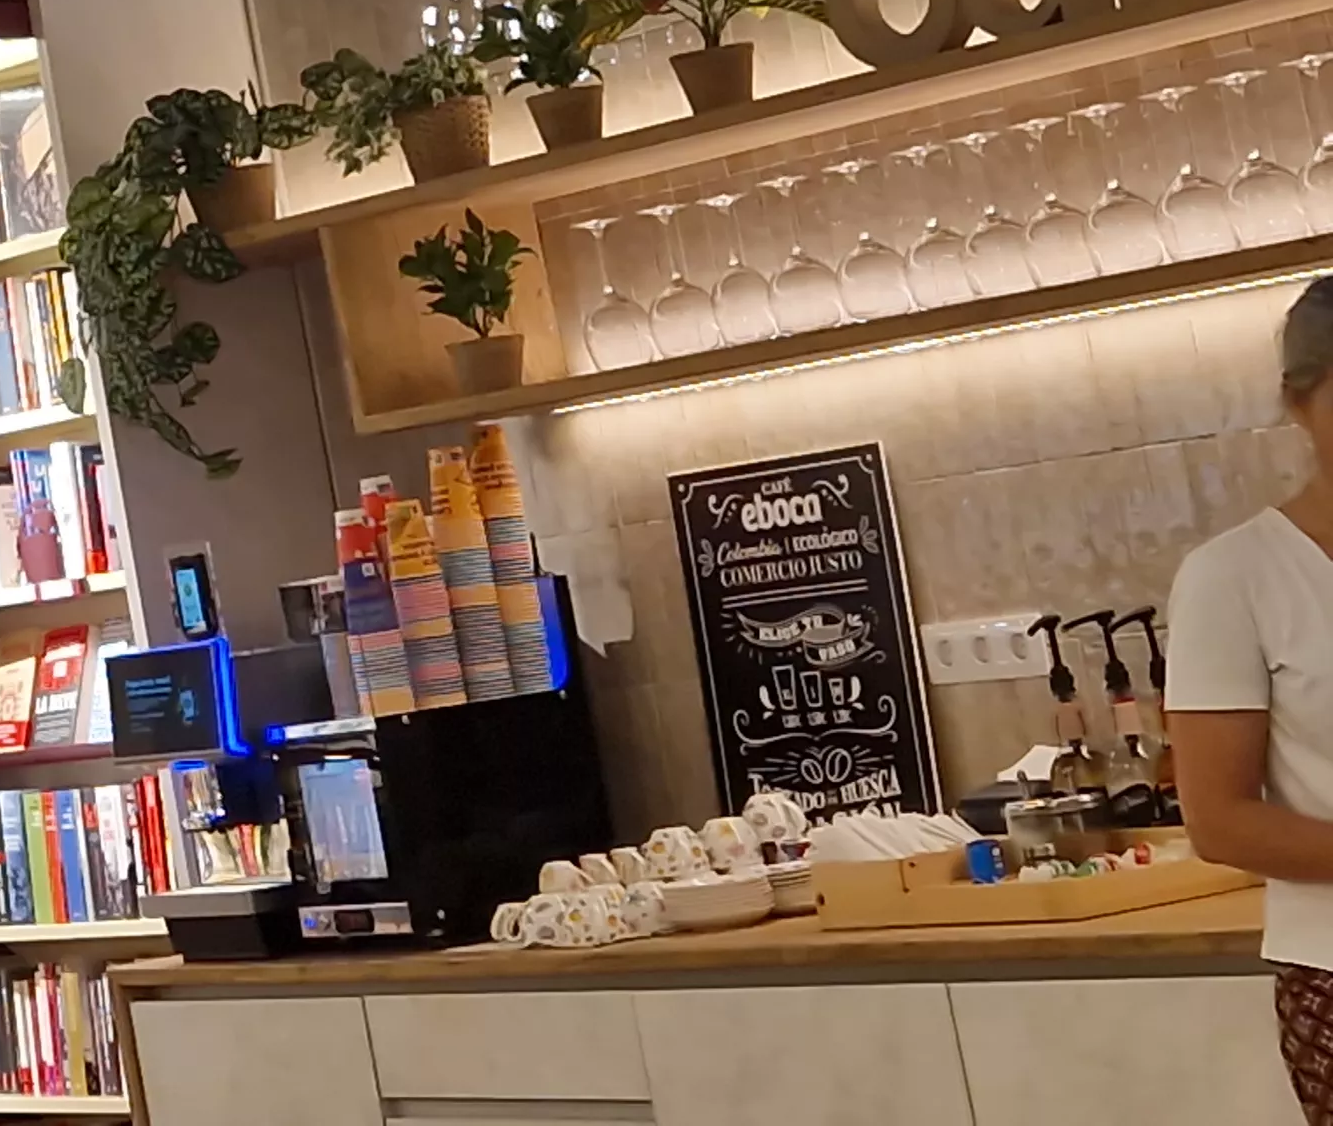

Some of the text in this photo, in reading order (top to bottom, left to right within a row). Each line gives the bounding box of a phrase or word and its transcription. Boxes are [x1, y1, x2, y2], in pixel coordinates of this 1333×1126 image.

[740, 492, 823, 532] eboca
[717, 538, 782, 566] Colombia
[720, 550, 863, 588] COMERCIO JUSTO
[840, 764, 902, 804] HUESCA
